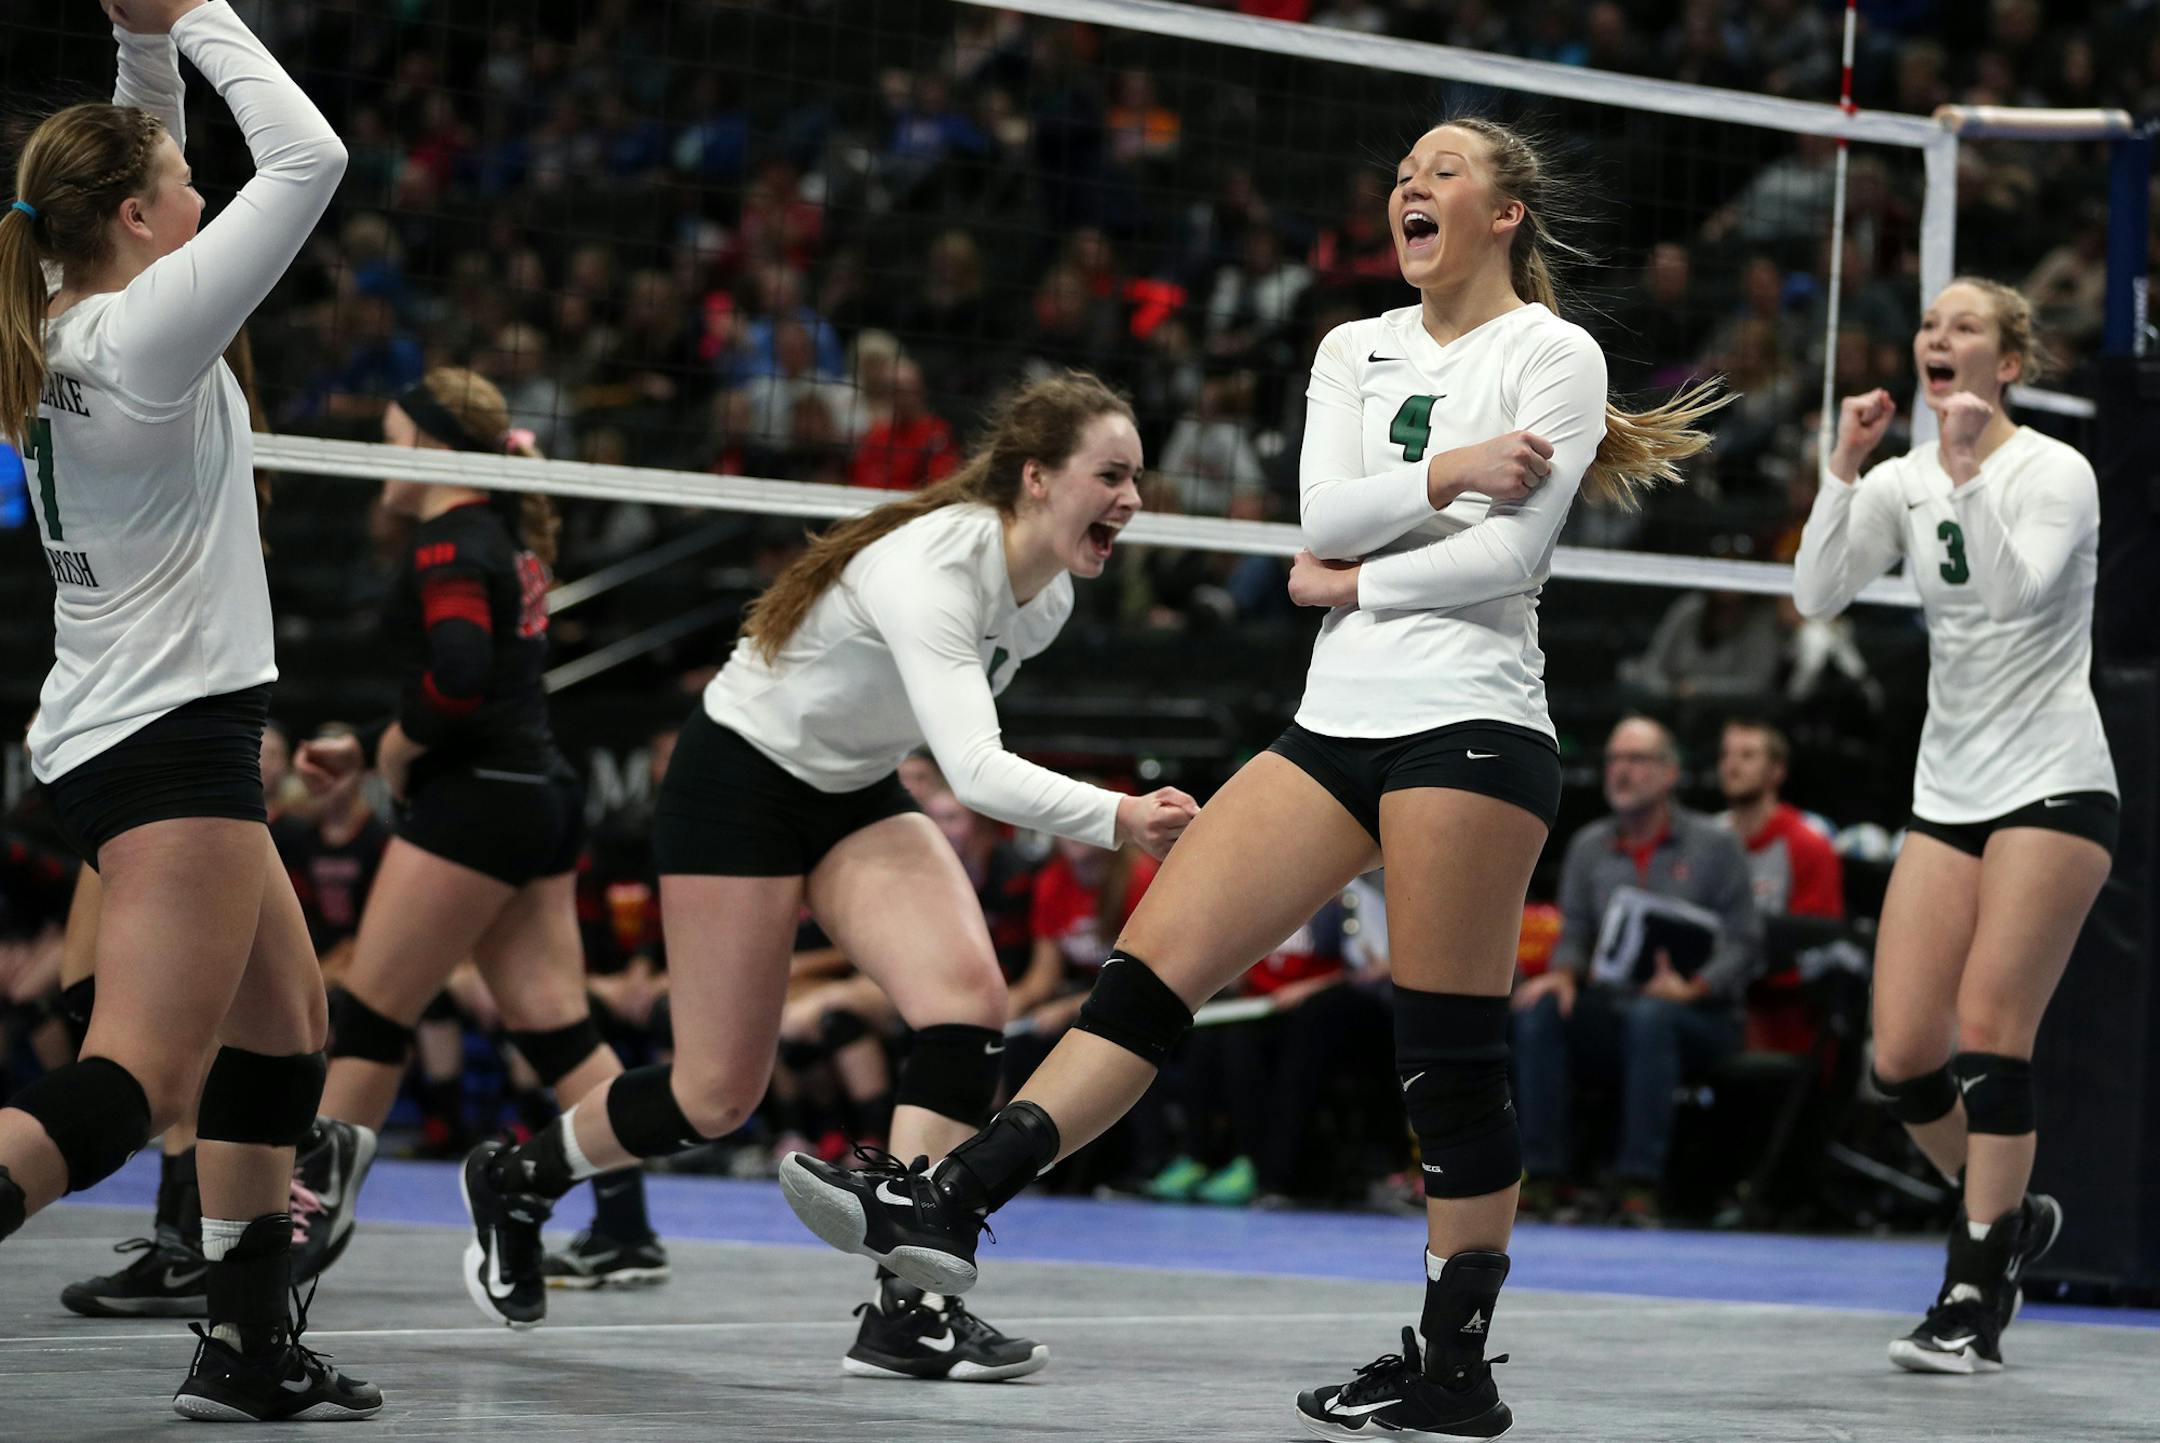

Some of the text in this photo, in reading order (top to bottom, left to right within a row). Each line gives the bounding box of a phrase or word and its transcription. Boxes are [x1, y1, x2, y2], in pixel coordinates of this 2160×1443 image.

[1389, 394, 1447, 463] 4
[23, 414, 64, 542] 7
[46, 547, 100, 587] RISH
[1937, 520, 1970, 586] 3
